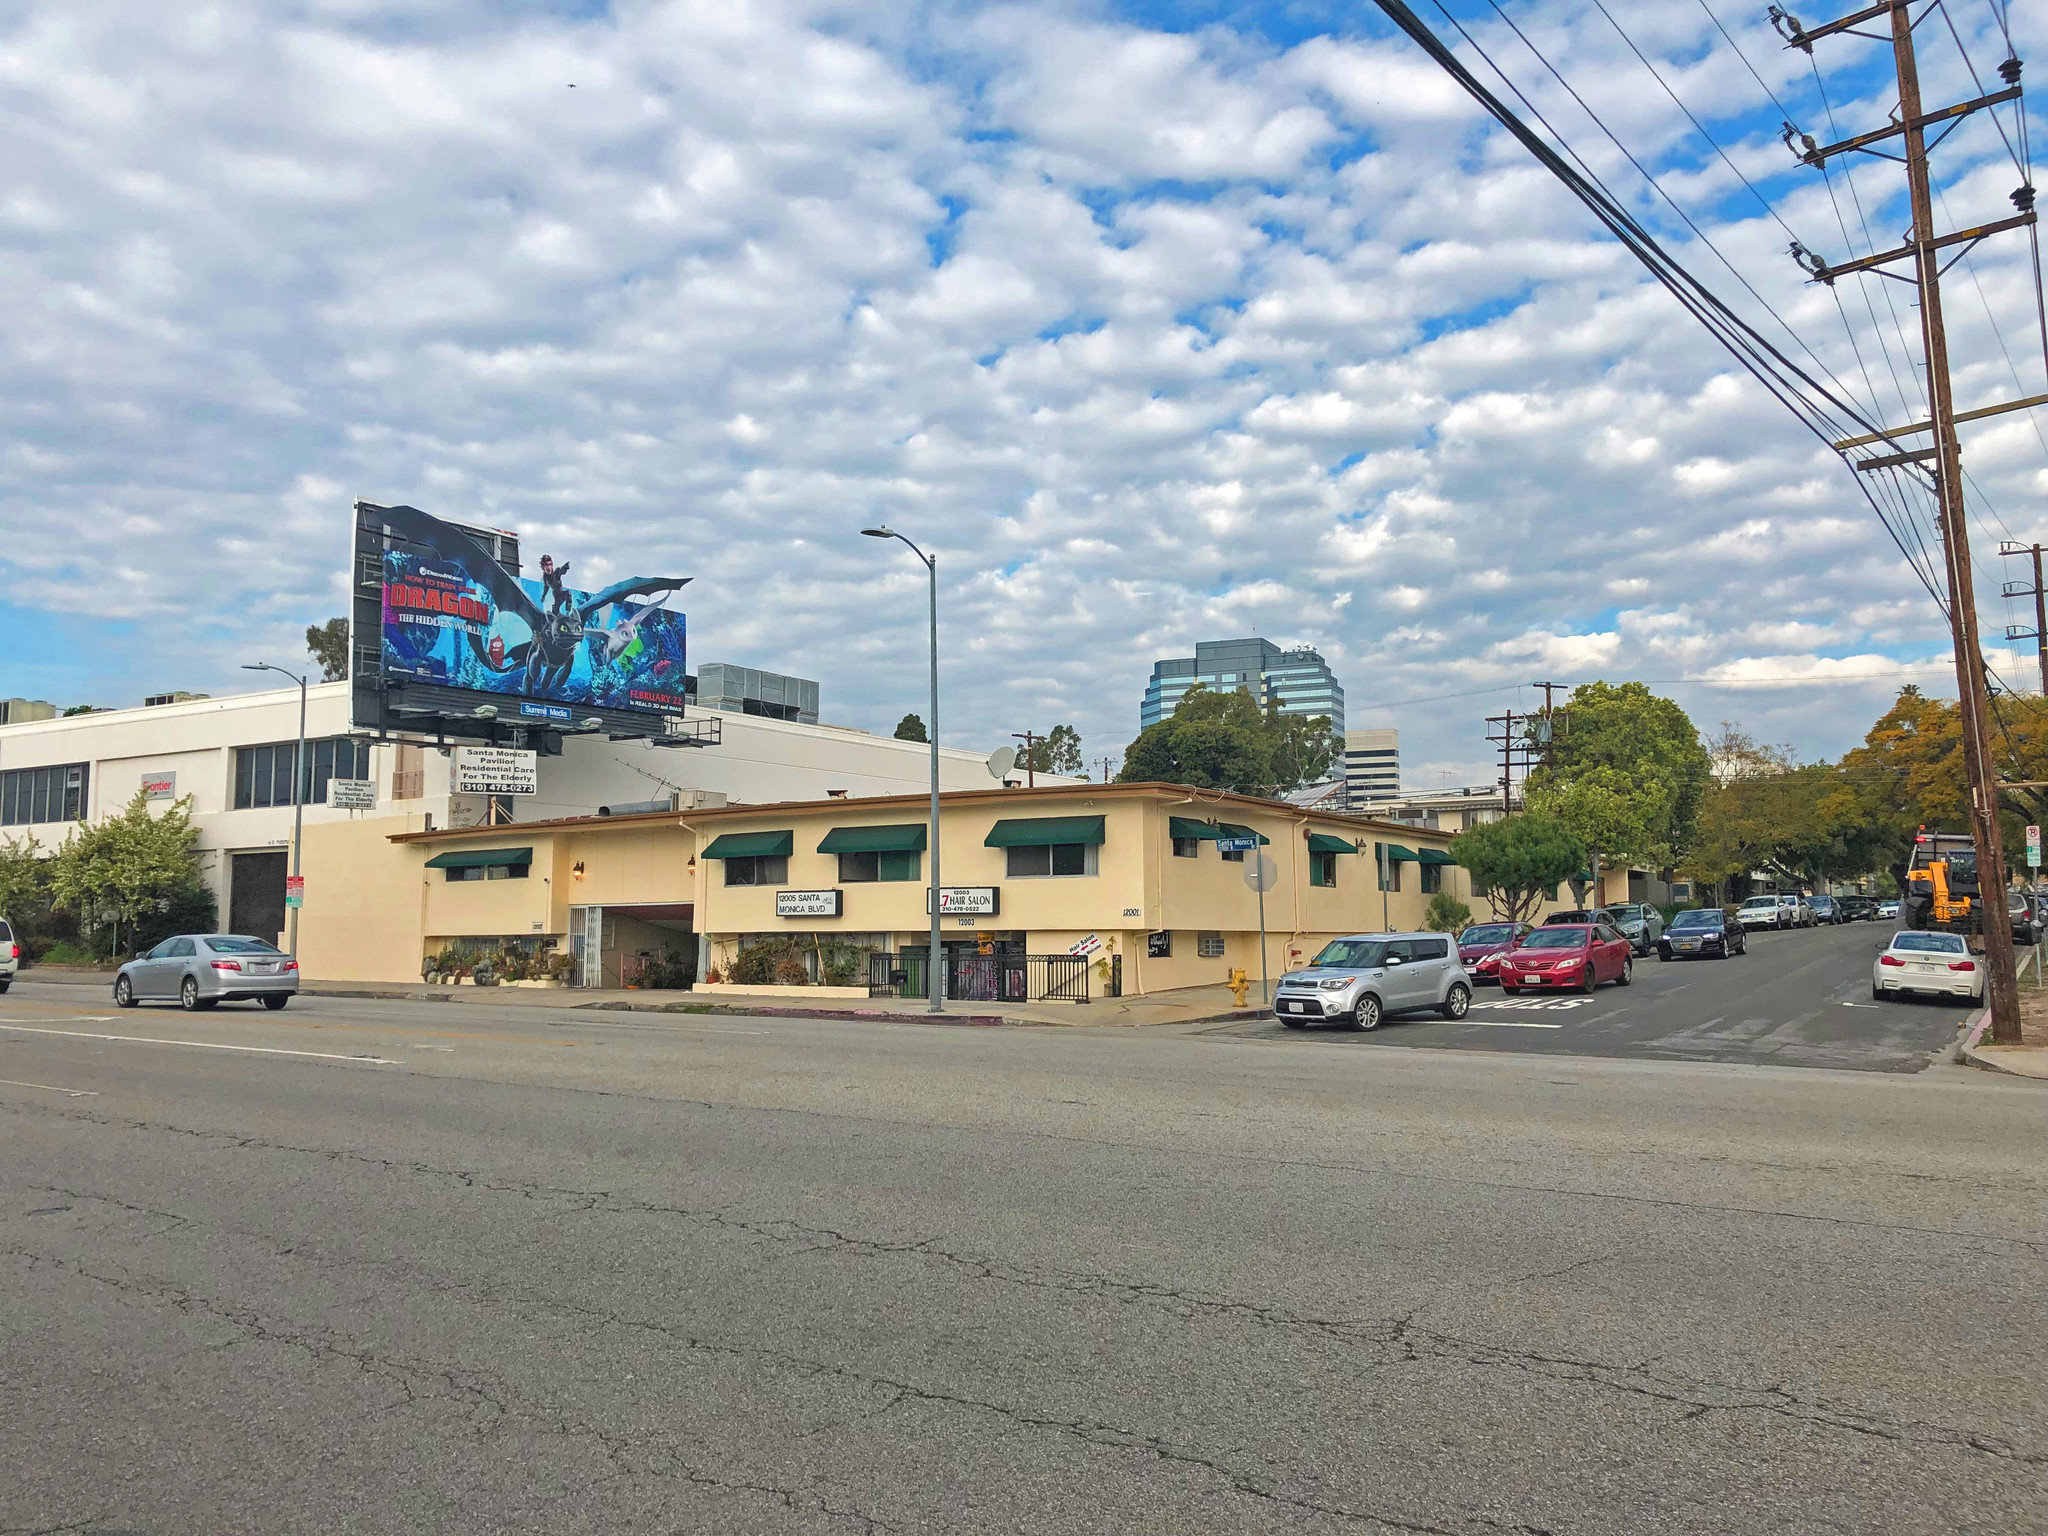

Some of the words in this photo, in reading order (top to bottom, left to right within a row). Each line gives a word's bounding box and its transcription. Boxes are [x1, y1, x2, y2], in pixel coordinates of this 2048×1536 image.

[405, 574, 423, 584] HOW
[425, 578, 435, 586] TO
[436, 580, 456, 590] TRAIN
[458, 586, 476, 595] YOUR
[390, 583, 489, 624] DRAGON
[398, 613, 414, 623] THE
[415, 615, 452, 628] HIDDEN
[454, 622, 482, 636] WORLD
[630, 689, 671, 704] FEBRUARY
[672, 696, 682, 705] 22
[525, 705, 547, 715] Summit
[550, 709, 567, 717] Media
[496, 750, 528, 758] Monica
[460, 764, 511, 773] Residential
[142, 781, 172, 791] Fontier
[461, 783, 486, 792] (310)
[489, 784, 534, 792] 478-0273
[779, 894, 796, 902] 12005
[798, 894, 820, 902] SANTA
[949, 896, 965, 906] HAIR
[968, 895, 991, 906] SALON
[779, 905, 805, 913] MONICA
[808, 905, 825, 913] BLVD
[1123, 908, 1139, 917] 12001
[958, 918, 975, 926] 12003
[1069, 943, 1080, 953] Hair
[1080, 934, 1095, 946] Salon
[1468, 999, 1595, 1010] STOP
